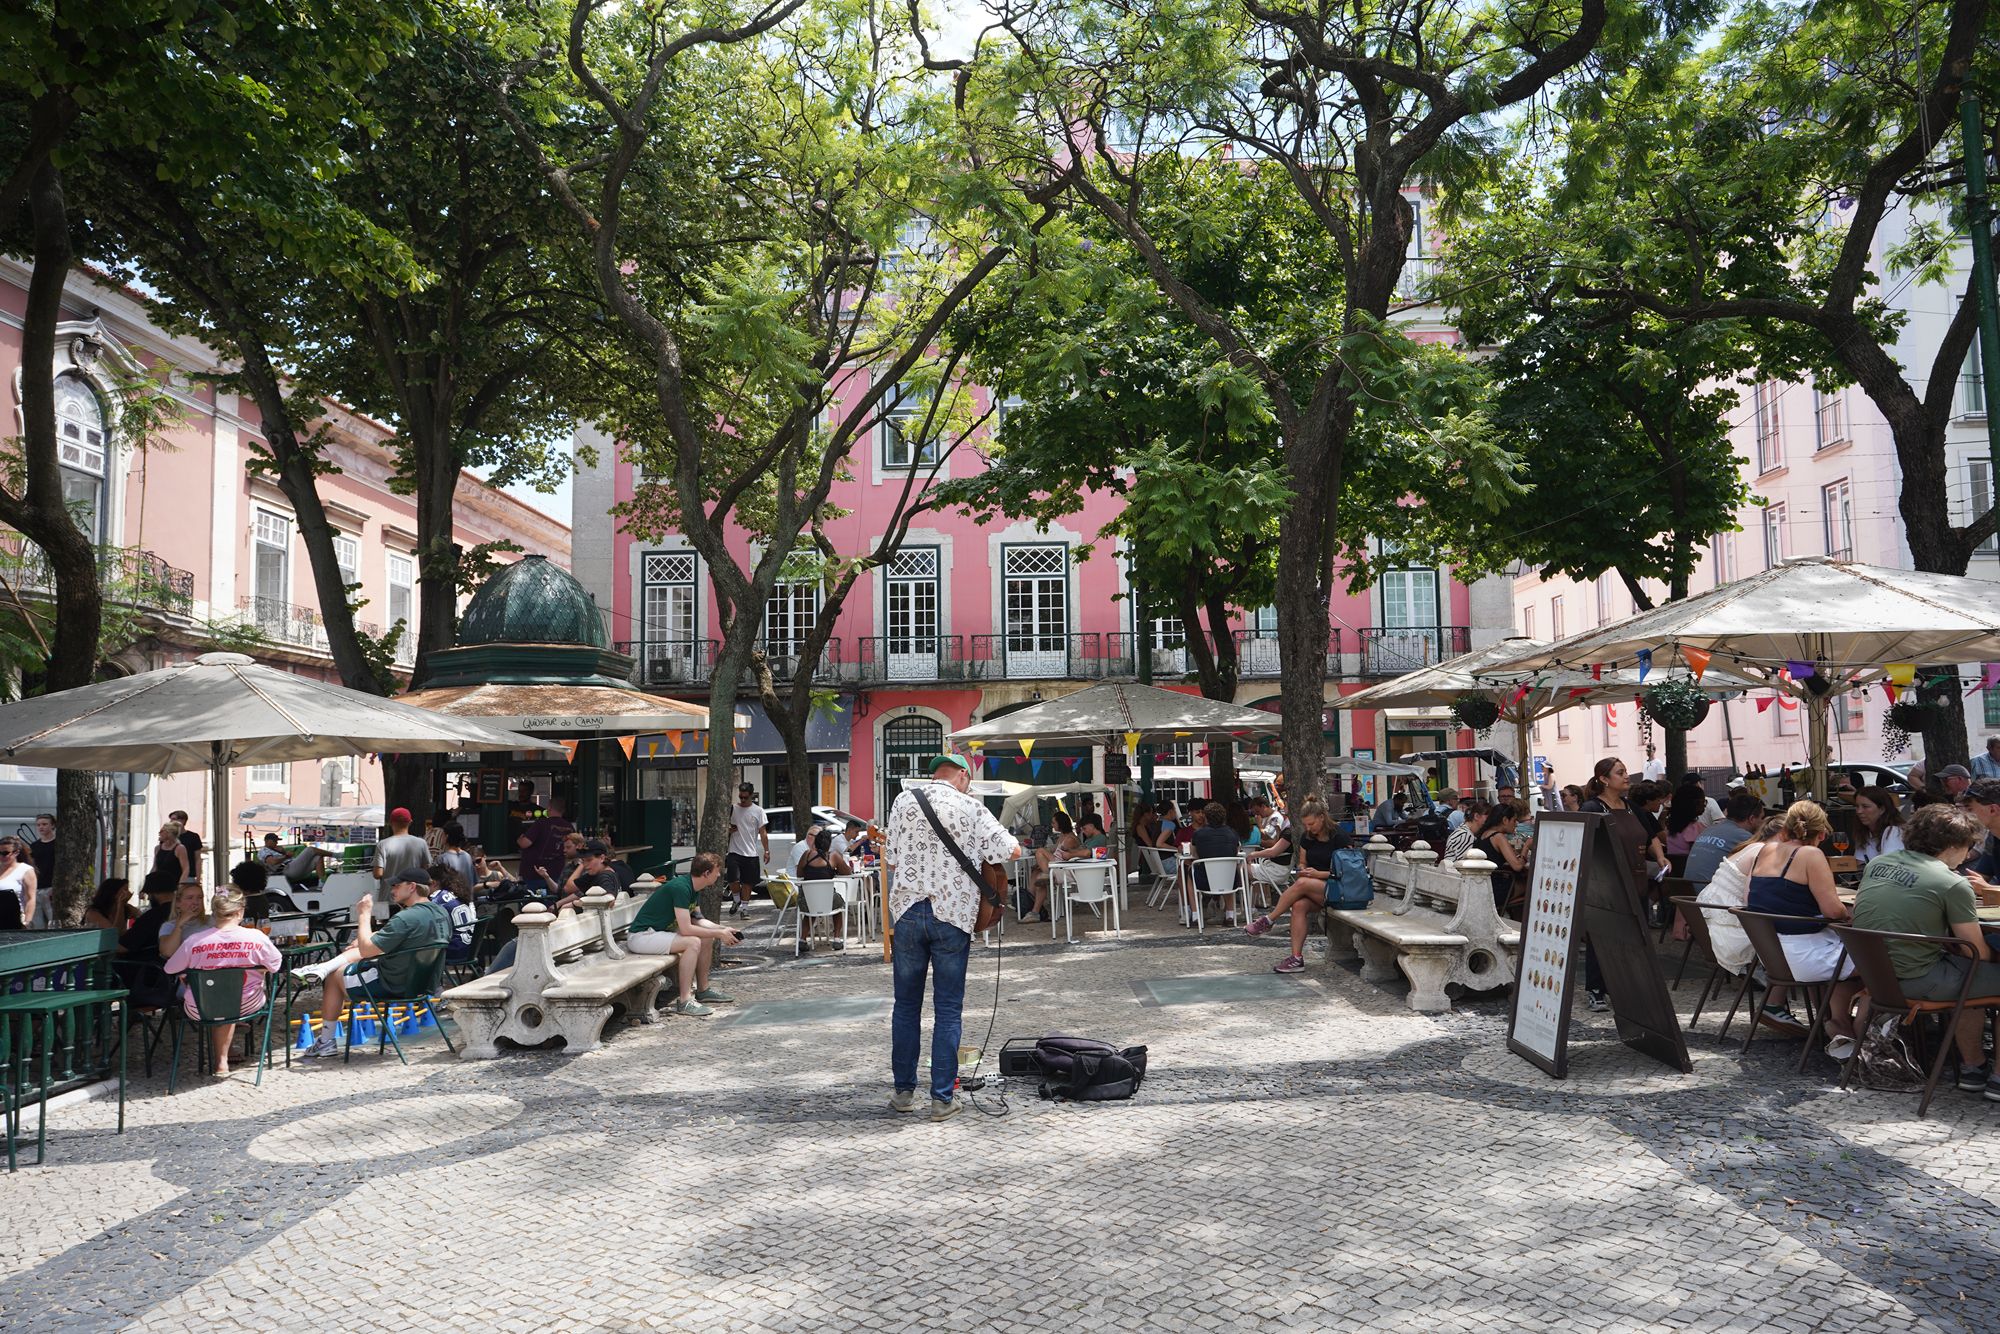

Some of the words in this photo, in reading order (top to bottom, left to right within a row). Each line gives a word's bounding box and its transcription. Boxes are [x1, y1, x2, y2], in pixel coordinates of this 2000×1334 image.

[1870, 863, 1919, 888] VOLTRON
[192, 943, 215, 954] FROM
[216, 942, 241, 951] PARIS
[243, 942, 253, 950] TO
